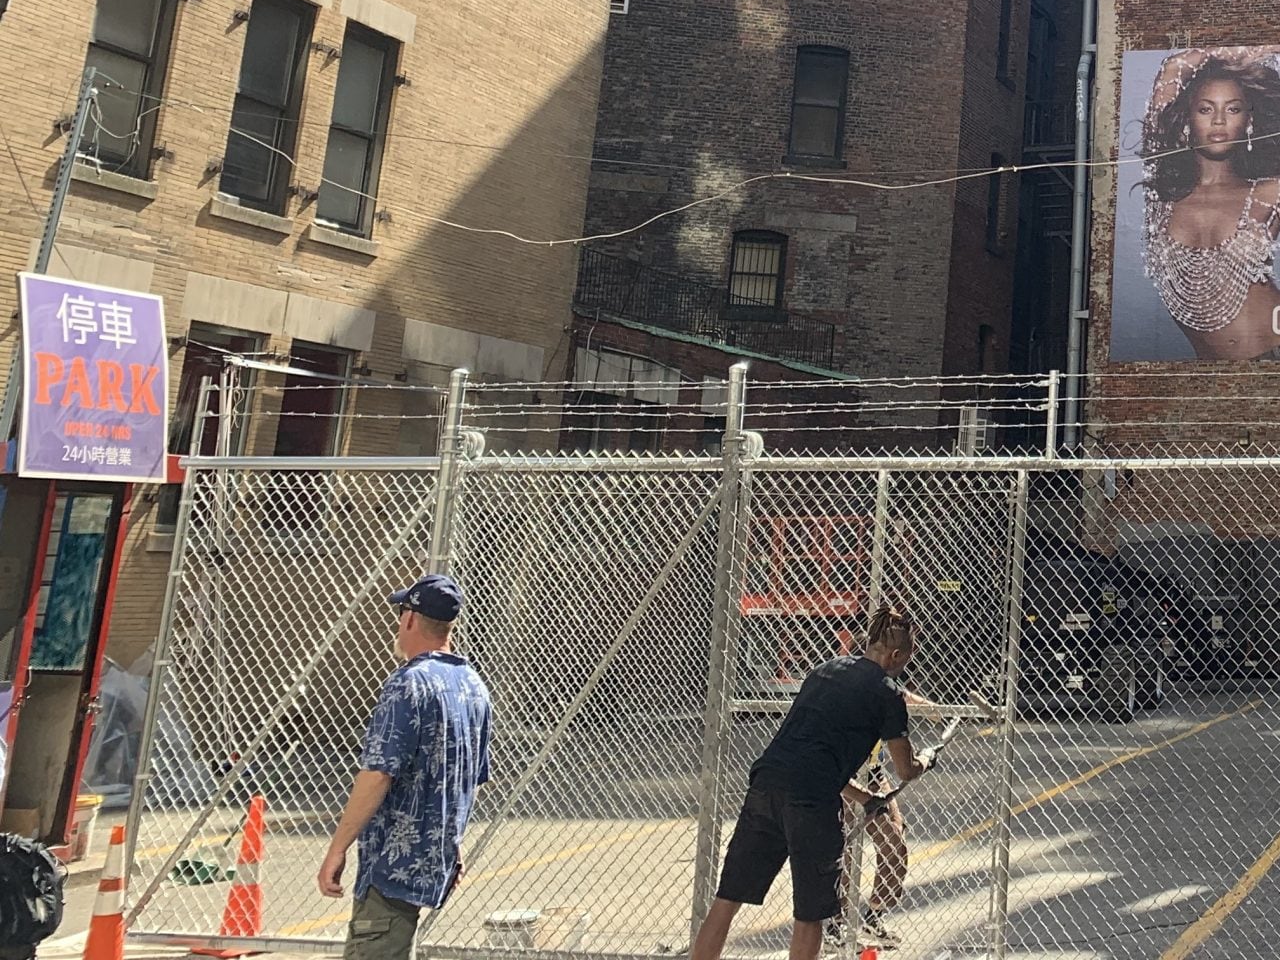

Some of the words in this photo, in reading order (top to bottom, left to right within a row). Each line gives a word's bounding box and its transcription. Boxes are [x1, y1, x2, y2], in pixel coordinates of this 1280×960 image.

[56, 292, 137, 349] 停車
[34, 352, 160, 416] PARK
[62, 445, 132, 466] 24小時營業
